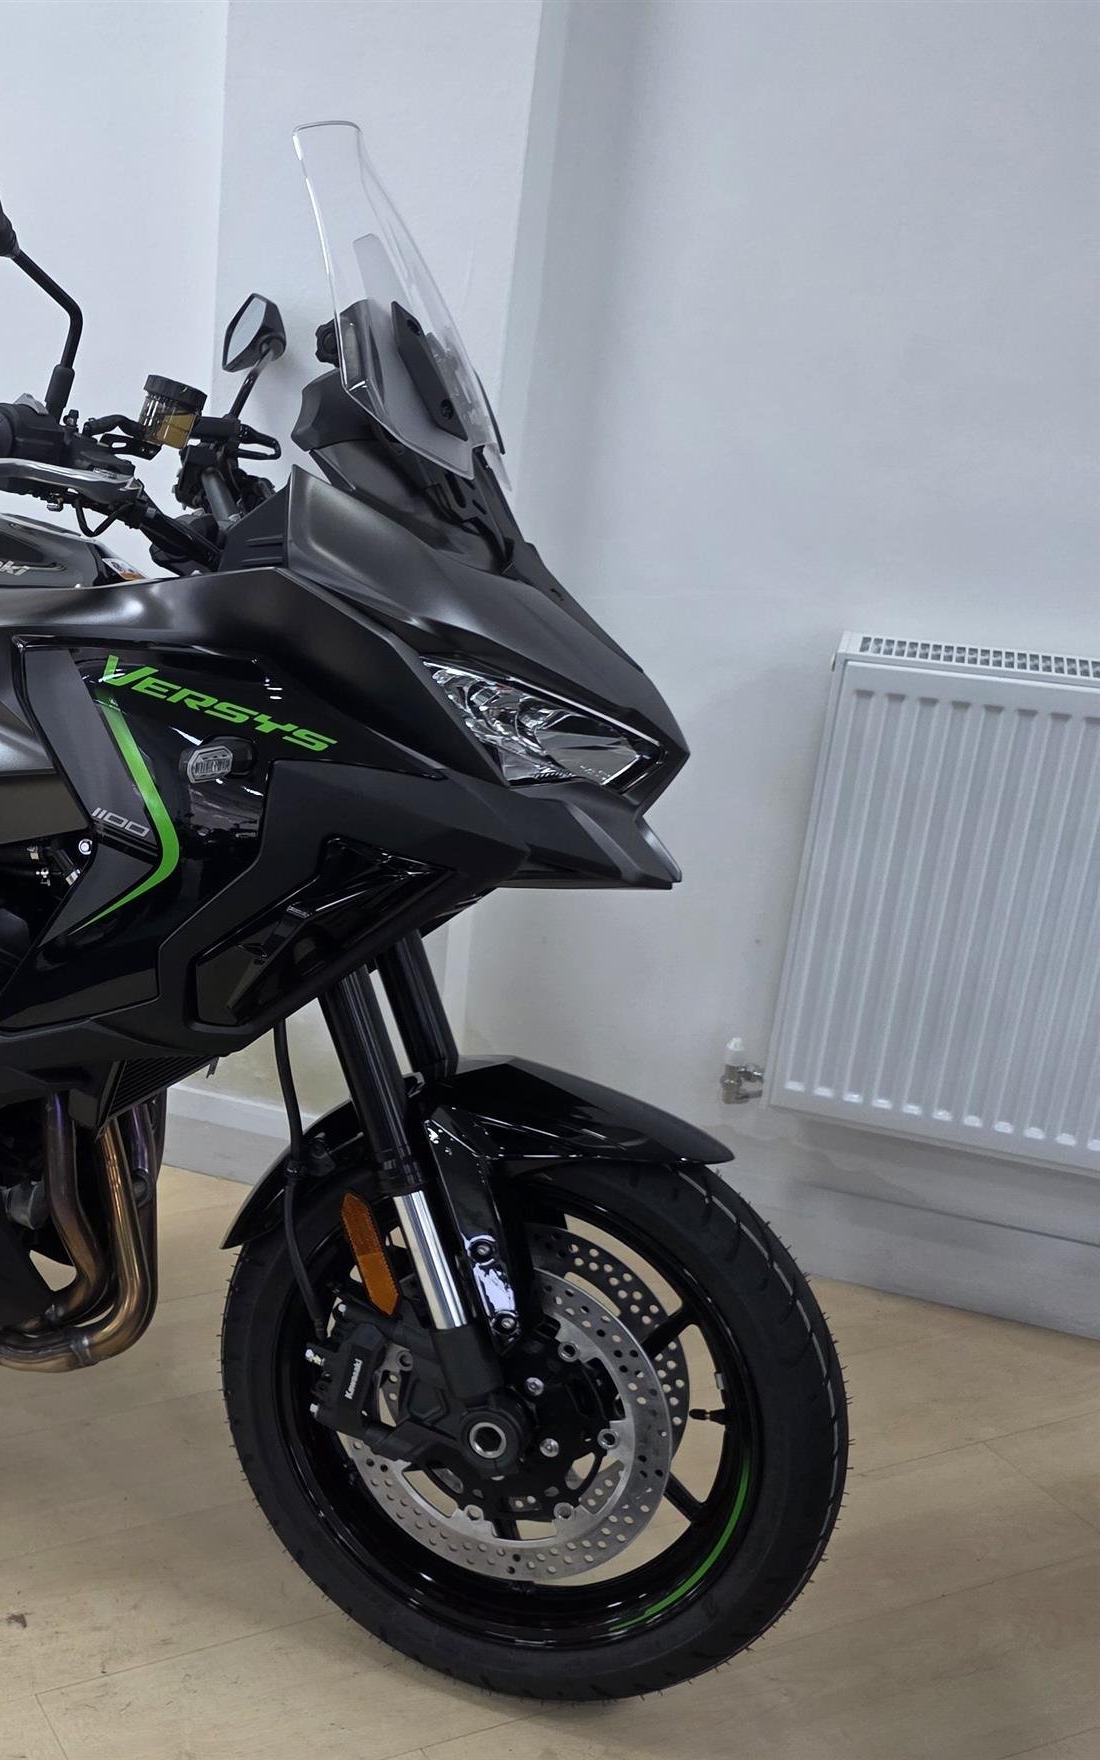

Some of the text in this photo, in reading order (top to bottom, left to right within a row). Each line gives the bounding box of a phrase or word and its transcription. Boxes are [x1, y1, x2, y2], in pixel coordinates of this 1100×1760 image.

[101, 654, 339, 752] VERSYS
[91, 807, 150, 837] 1100
[344, 1357, 364, 1401] Kawasaki
